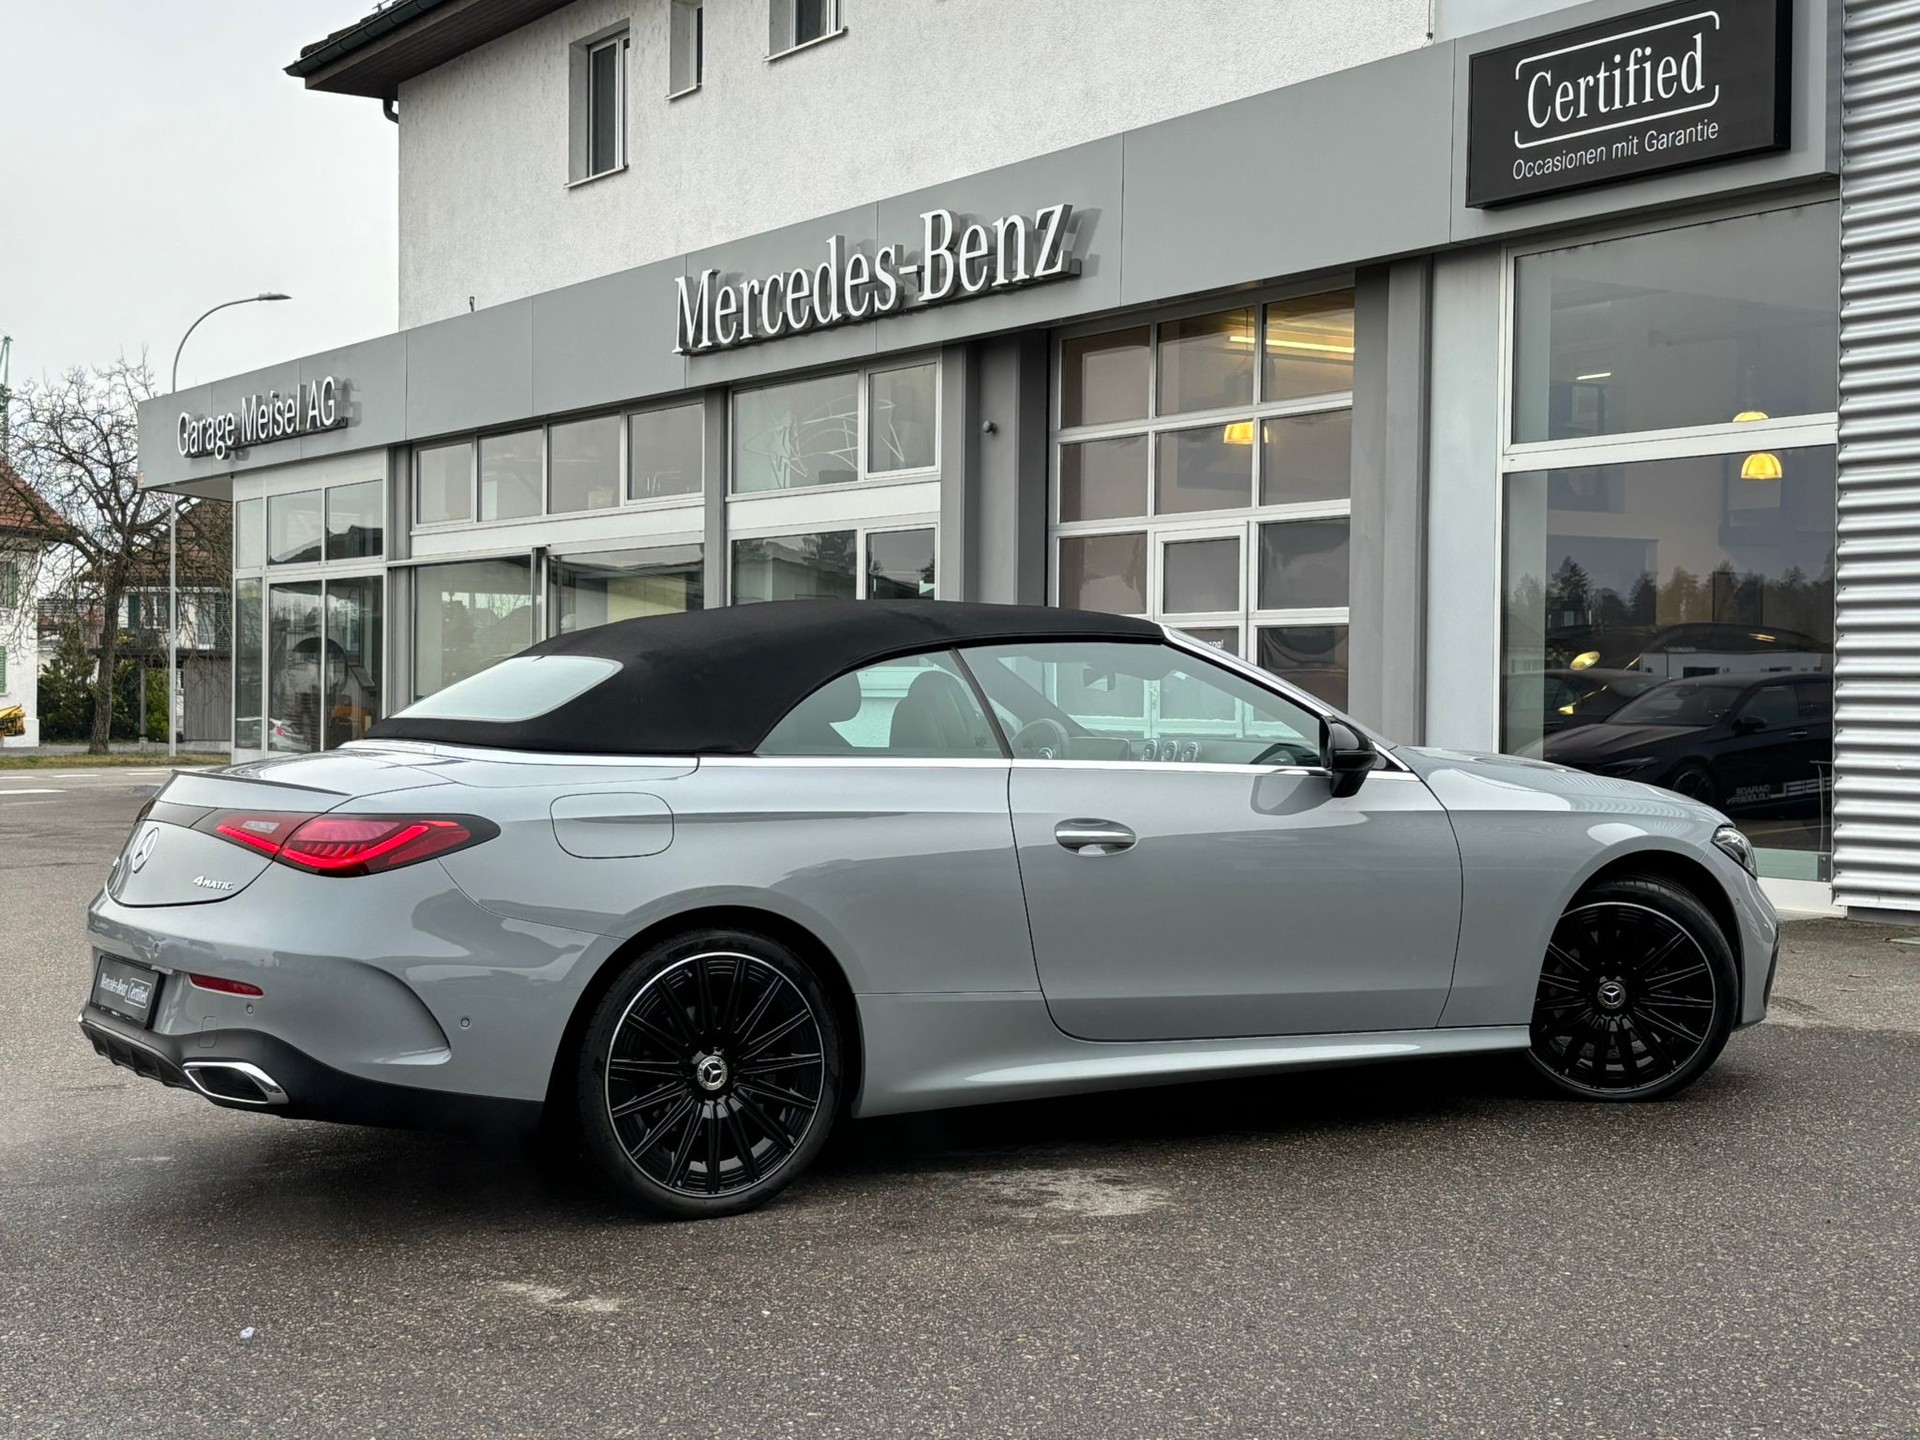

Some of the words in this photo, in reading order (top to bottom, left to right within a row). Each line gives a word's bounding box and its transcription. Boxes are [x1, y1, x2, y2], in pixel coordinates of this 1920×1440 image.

[1527, 32, 1705, 129] Certified
[1512, 145, 1606, 181] Occasionen
[1612, 135, 1639, 160] mit
[1644, 118, 1720, 153] Garantie
[672, 203, 1073, 355] Mercedes-Benz
[177, 411, 236, 461] Garage
[241, 383, 302, 443] Meisel
[305, 375, 336, 430] AG
[193, 875, 233, 890] 4MATIC
